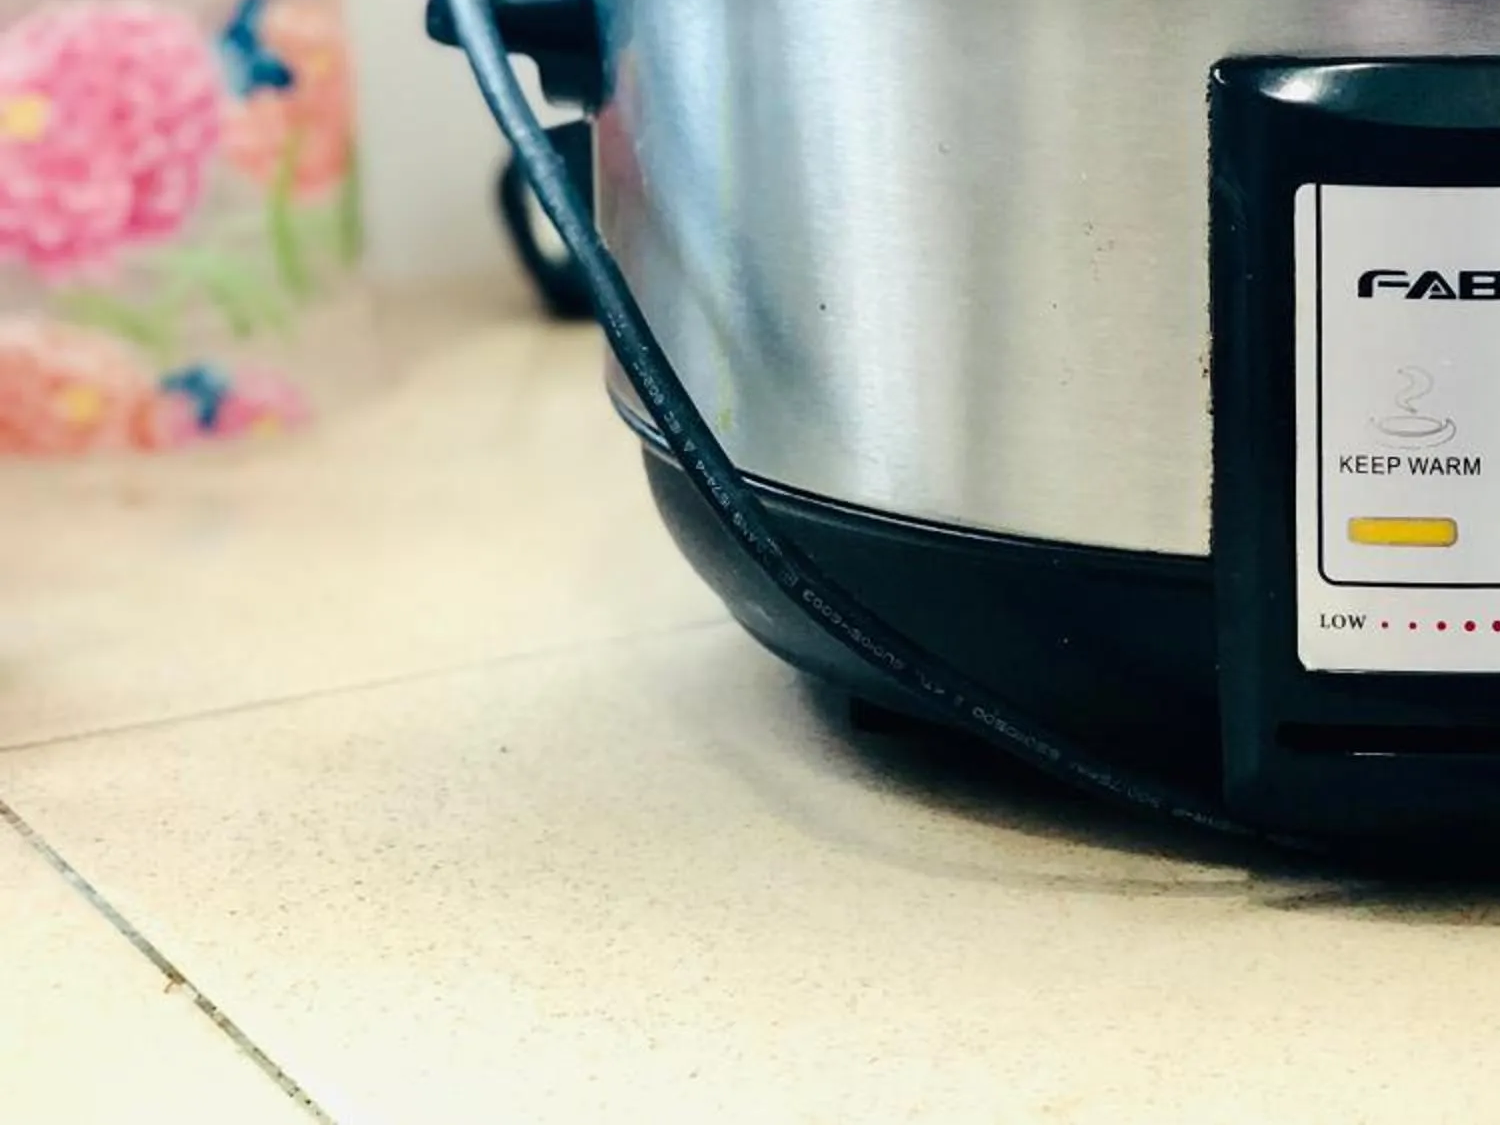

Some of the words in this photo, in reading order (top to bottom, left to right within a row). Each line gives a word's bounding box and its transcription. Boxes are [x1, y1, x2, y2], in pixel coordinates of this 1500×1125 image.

[1339, 455, 1401, 475] KEEP
[1408, 456, 1481, 476] WARM
[1319, 613, 1366, 630] LOW
